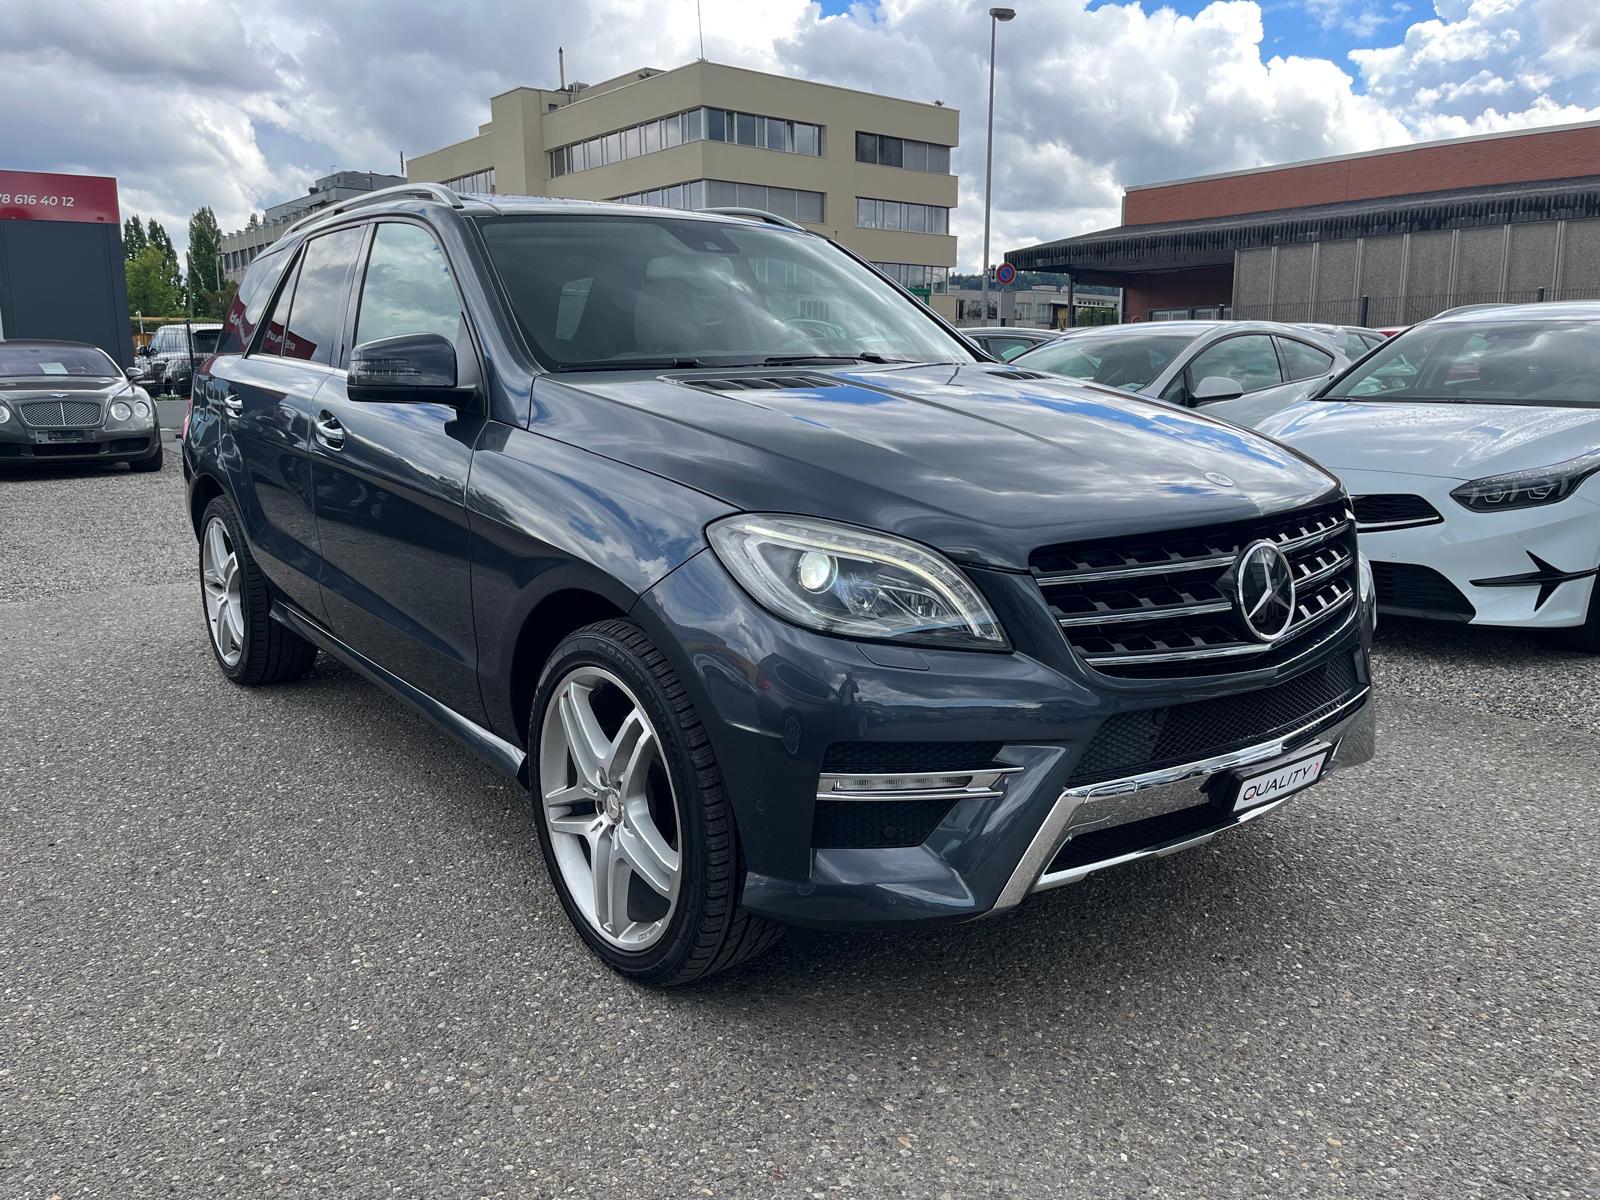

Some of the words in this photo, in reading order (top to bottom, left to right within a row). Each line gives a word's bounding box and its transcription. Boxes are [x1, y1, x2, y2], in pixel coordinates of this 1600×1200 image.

[14, 194, 37, 205] 616
[40, 195, 58, 206] 40
[61, 196, 75, 207] 12
[1243, 764, 1312, 801] QUALITY
